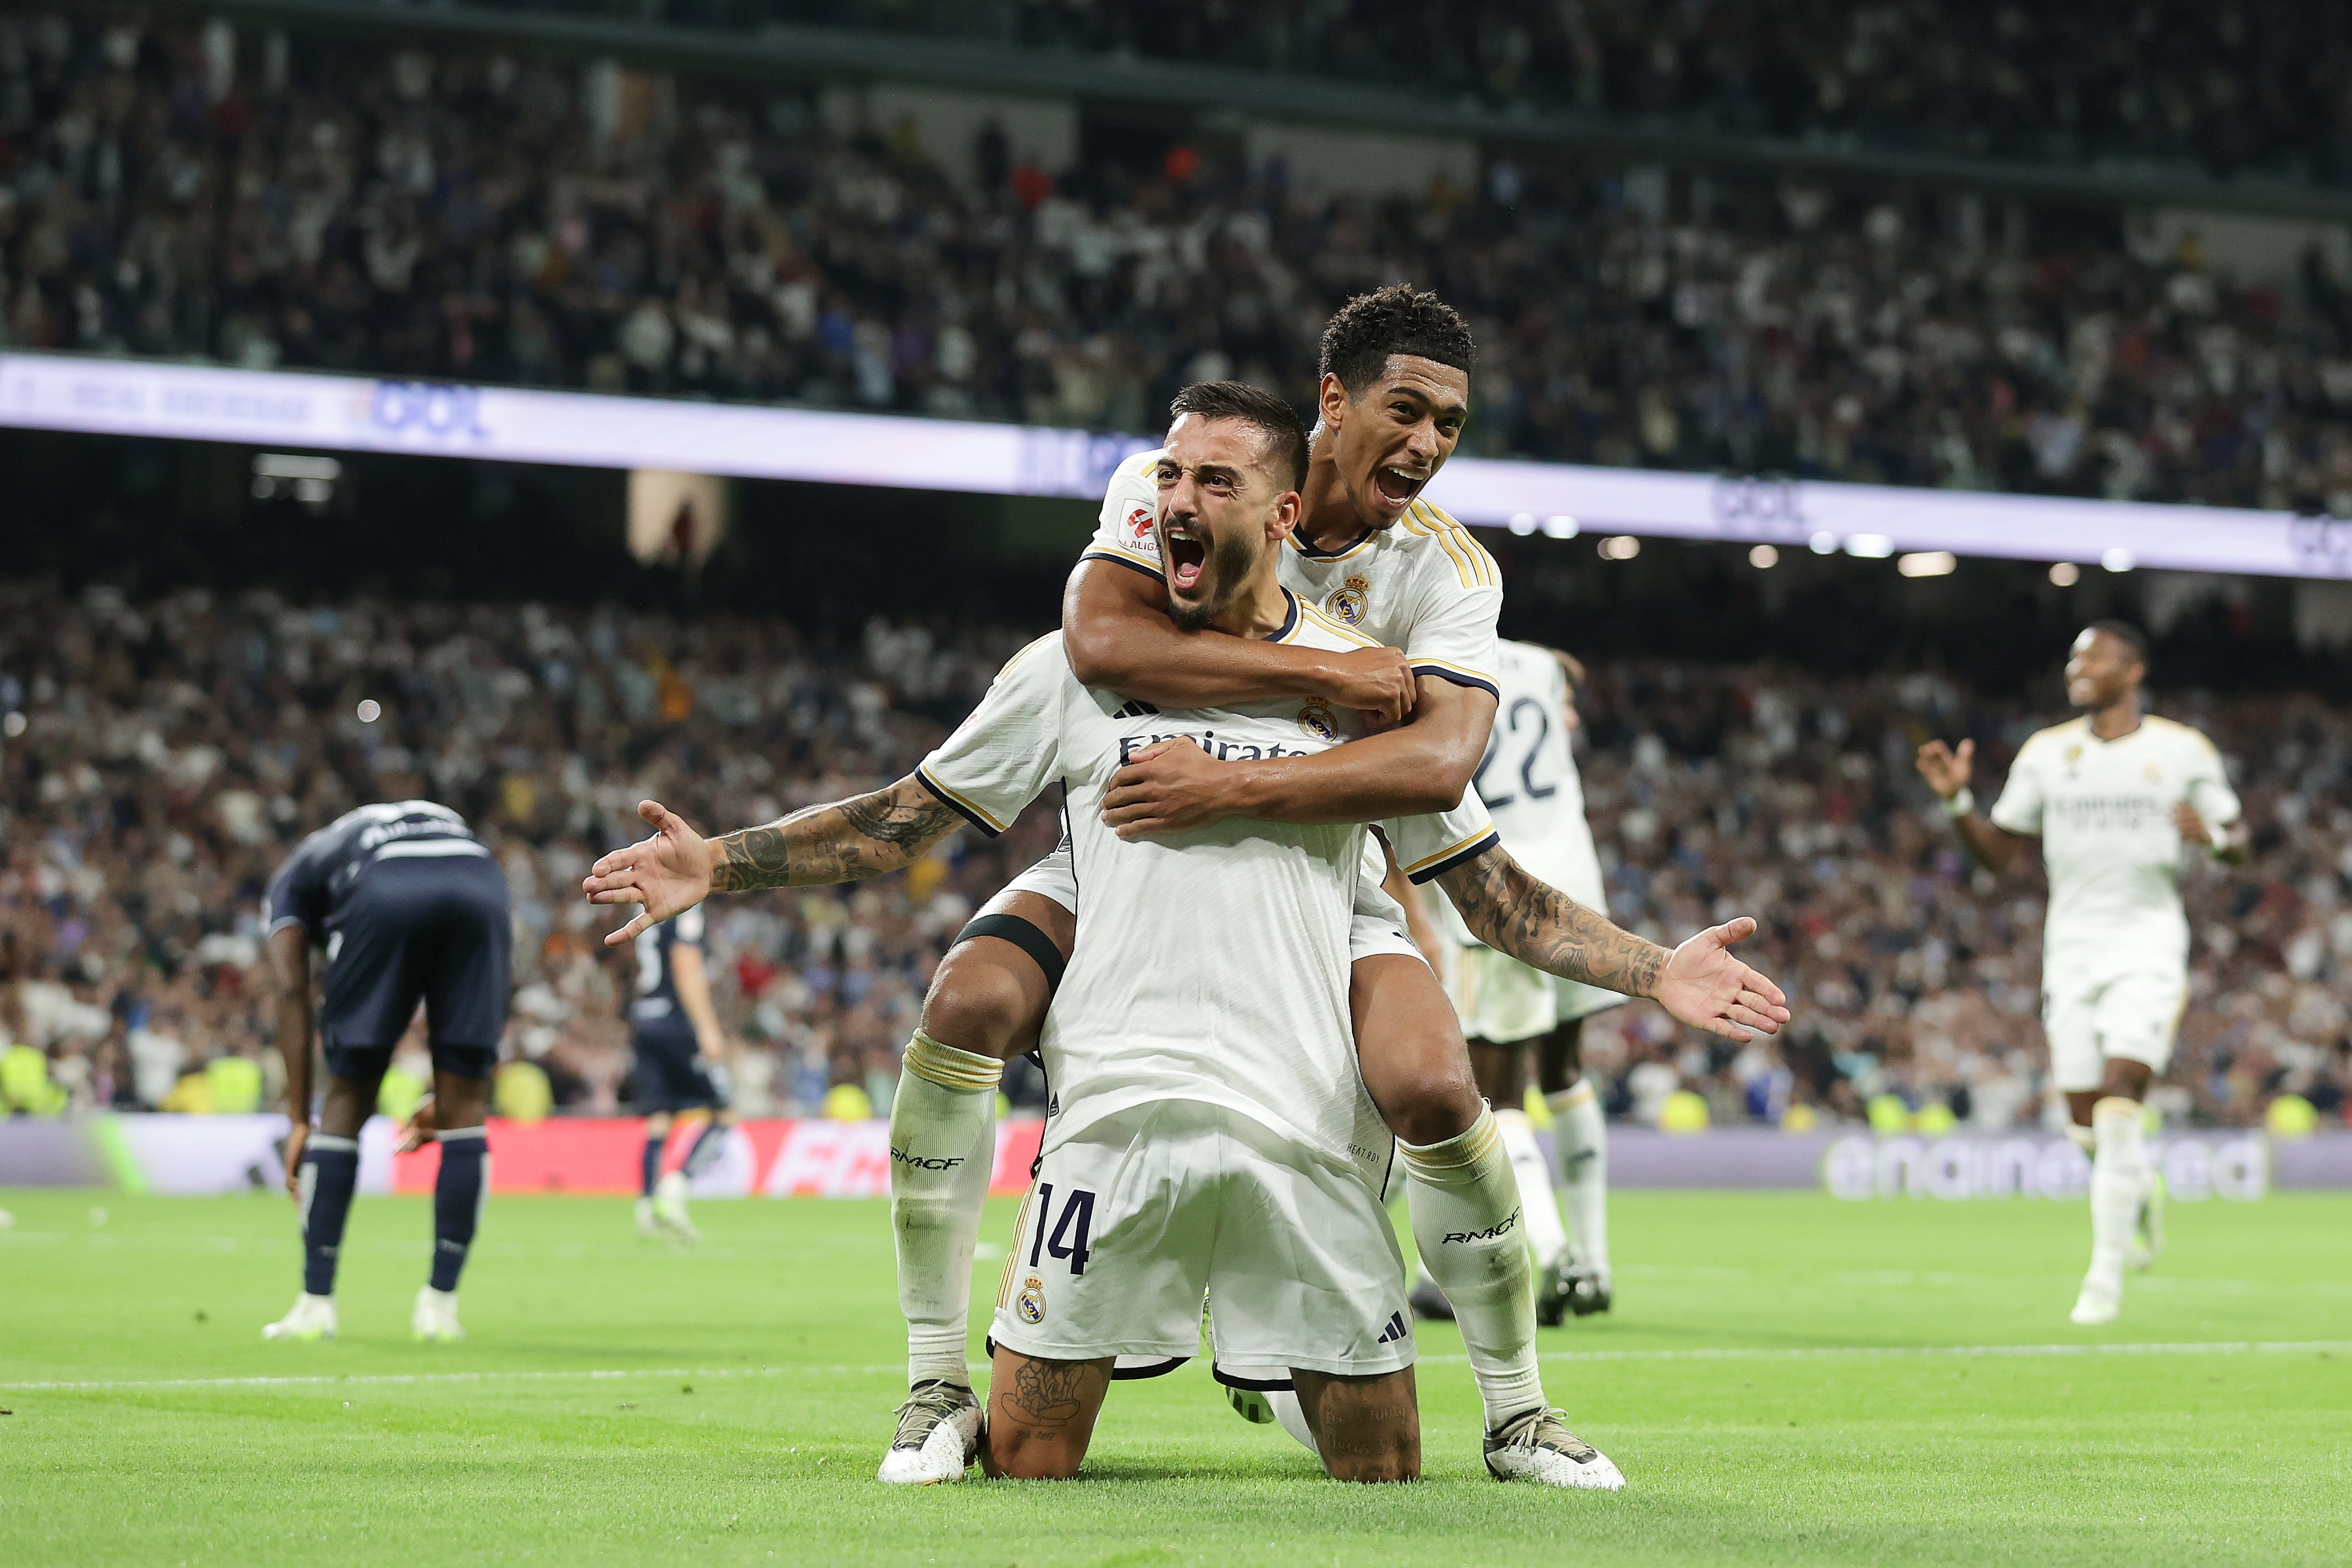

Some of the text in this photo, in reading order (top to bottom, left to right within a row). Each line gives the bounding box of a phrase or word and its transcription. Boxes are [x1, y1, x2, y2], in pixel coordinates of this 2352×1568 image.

[890, 1146, 965, 1171] RMCF
[1347, 1143, 1380, 1163] HEAT.RDY
[1029, 1182, 1096, 1276] 14
[1441, 1206, 1520, 1244] RMCF
